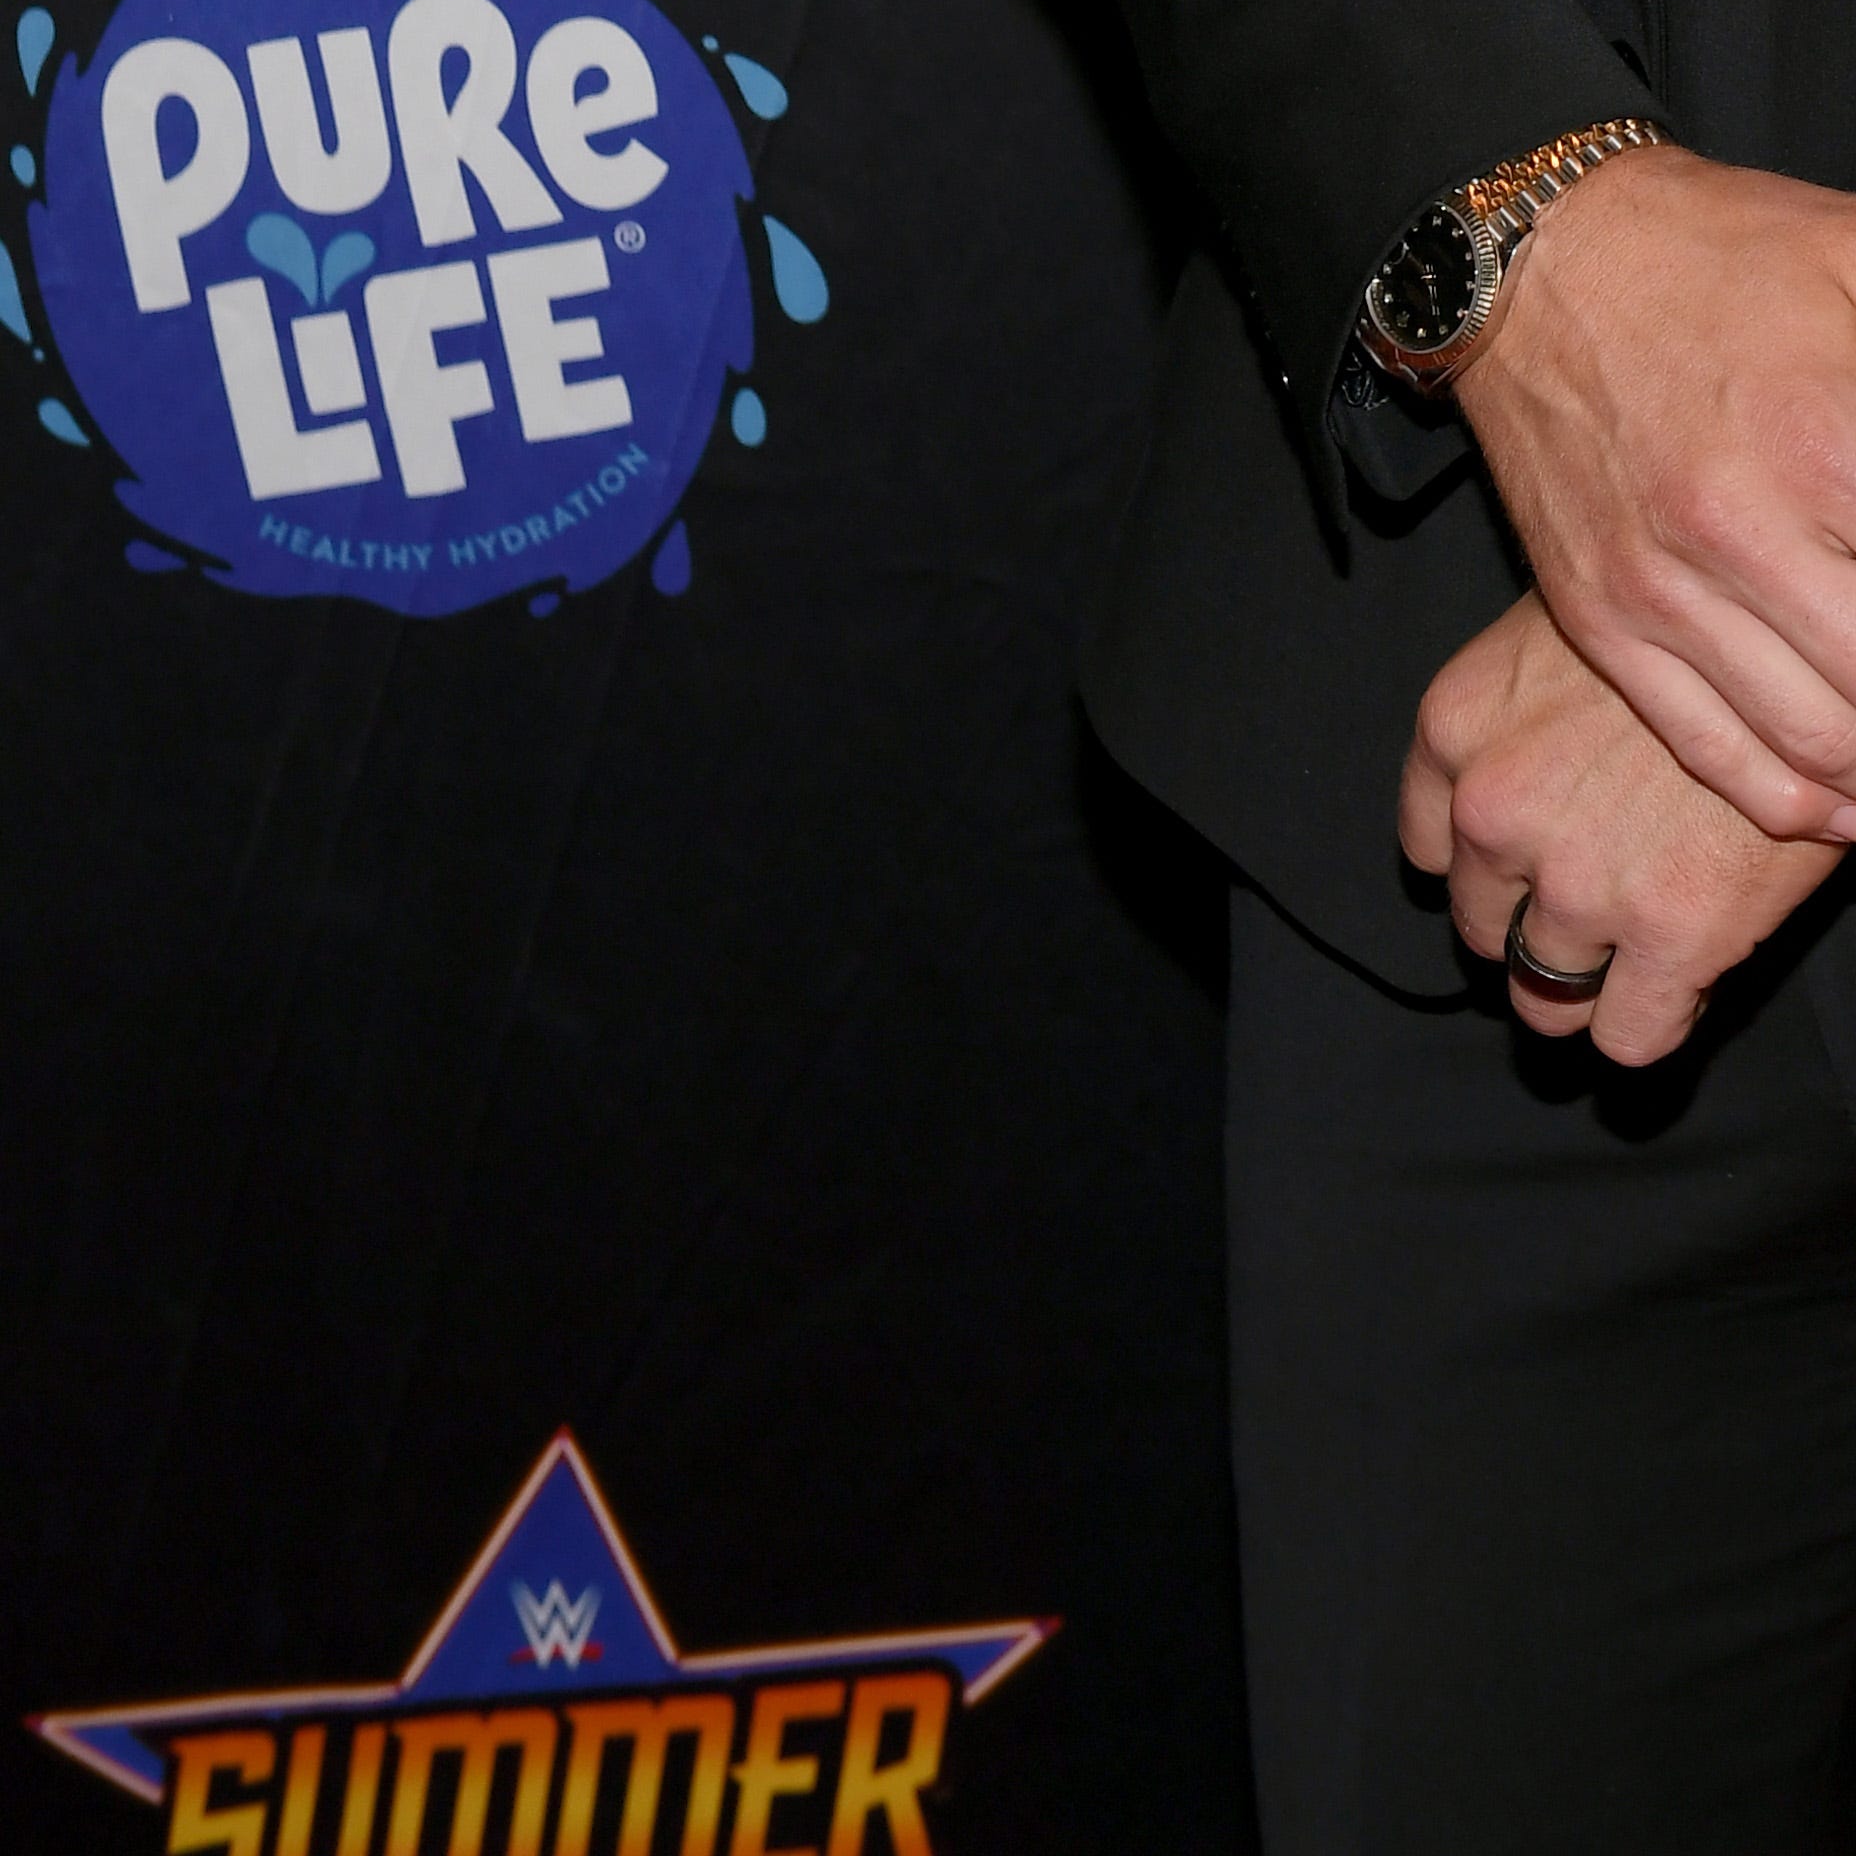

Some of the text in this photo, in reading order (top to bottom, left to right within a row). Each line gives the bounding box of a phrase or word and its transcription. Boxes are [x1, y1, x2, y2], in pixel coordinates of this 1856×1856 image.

[259, 442, 649, 570] HEALTHY HYDRATION
[168, 1675, 950, 1856] SUMMER
